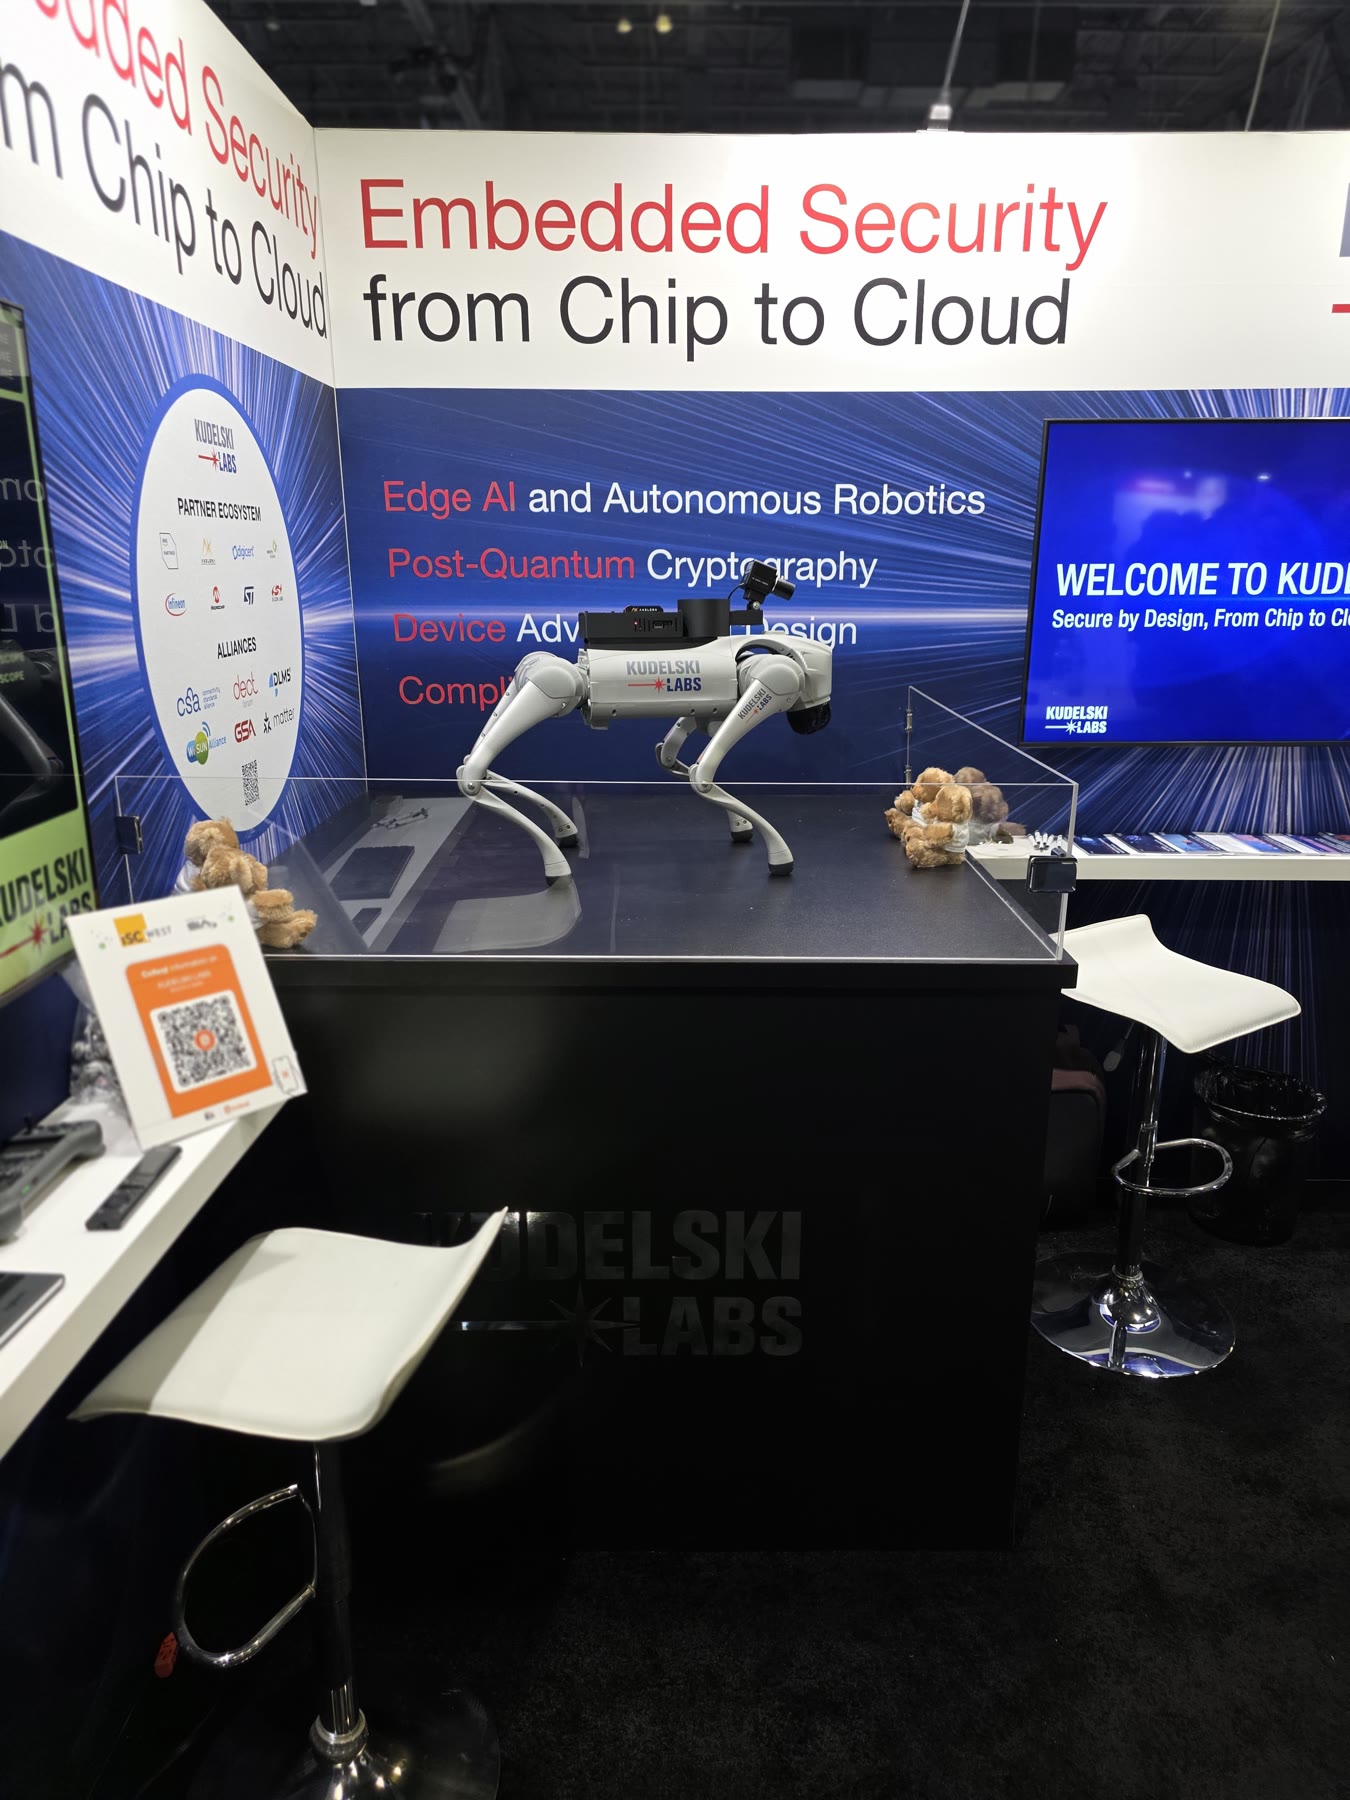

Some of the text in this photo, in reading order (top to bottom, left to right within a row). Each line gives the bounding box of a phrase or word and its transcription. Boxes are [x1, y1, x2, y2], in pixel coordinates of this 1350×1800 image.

[201, 65, 318, 259] Security
[81, 93, 196, 275] Chip
[205, 188, 242, 286] to
[251, 220, 328, 340] Cloud
[360, 178, 1108, 271] Embedded Security
[363, 274, 1071, 362] from Chip to Cloud
[194, 418, 235, 450] KUDELSKI
[217, 451, 237, 474] LABS
[177, 497, 262, 522] PARTNER ECOSYSTEM
[383, 480, 986, 520] Edge AI and Autonomous Robotics
[388, 547, 635, 580] Post-Quantum
[1056, 561, 1219, 597] WELCOME
[1227, 561, 1268, 596] TO
[393, 612, 506, 643] Device
[1052, 607, 1350, 632] Secure by Design, From Chip to Cl
[217, 636, 257, 659] ALLIANCES
[626, 660, 700, 675] KUDELSKI
[398, 675, 513, 711] Compl
[666, 677, 702, 692] LABS
[272, 707, 295, 728] matter
[738, 687, 767, 720] KUDELSKI
[757, 693, 773, 711] LABS
[1045, 706, 1109, 720] KUDELSKI
[234, 719, 257, 743] GSA
[1076, 721, 1107, 734] LABS
[0, 847, 88, 928] UDELSKI
[623, 1296, 802, 1356] LABS
